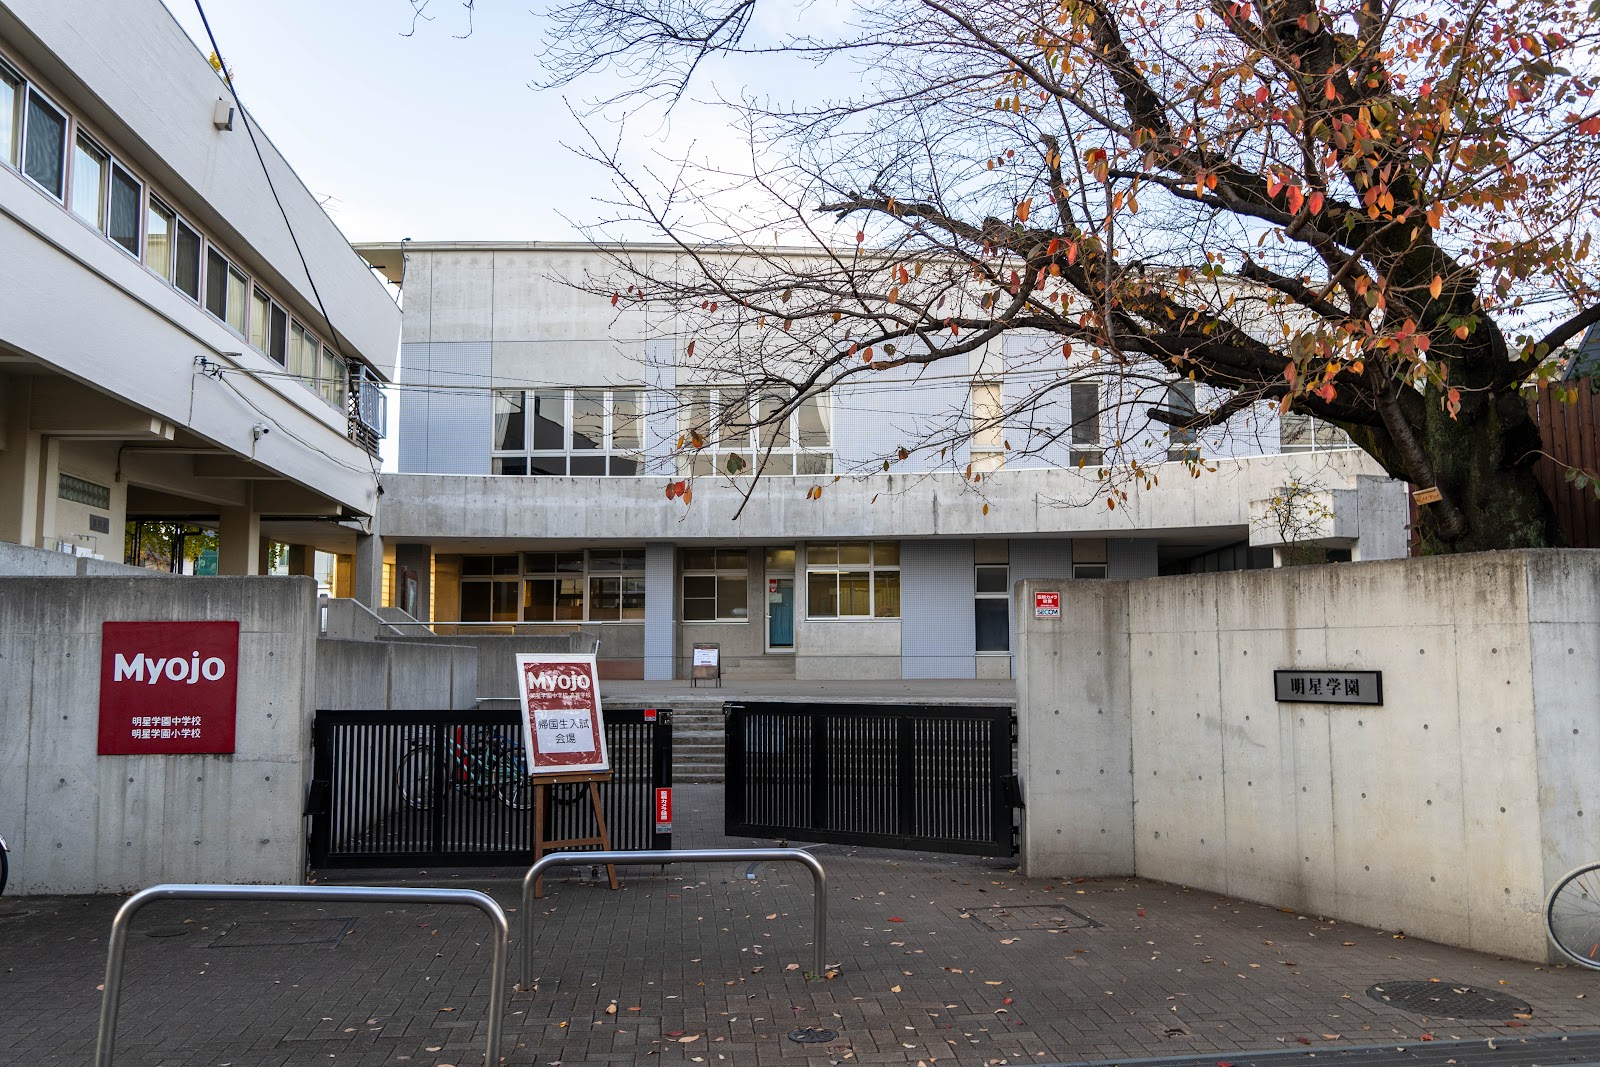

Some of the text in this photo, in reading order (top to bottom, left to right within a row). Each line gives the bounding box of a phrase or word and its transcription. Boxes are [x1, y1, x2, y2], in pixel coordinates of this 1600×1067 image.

[114, 650, 226, 685] Myojo
[527, 670, 591, 692] Myojo
[1290, 677, 1360, 697] 明星学園
[131, 716, 202, 727] 明星学園中学校
[538, 718, 590, 730] 帰国生入試
[131, 728, 202, 739] 明星学園小学校
[555, 732, 577, 744] 会場
